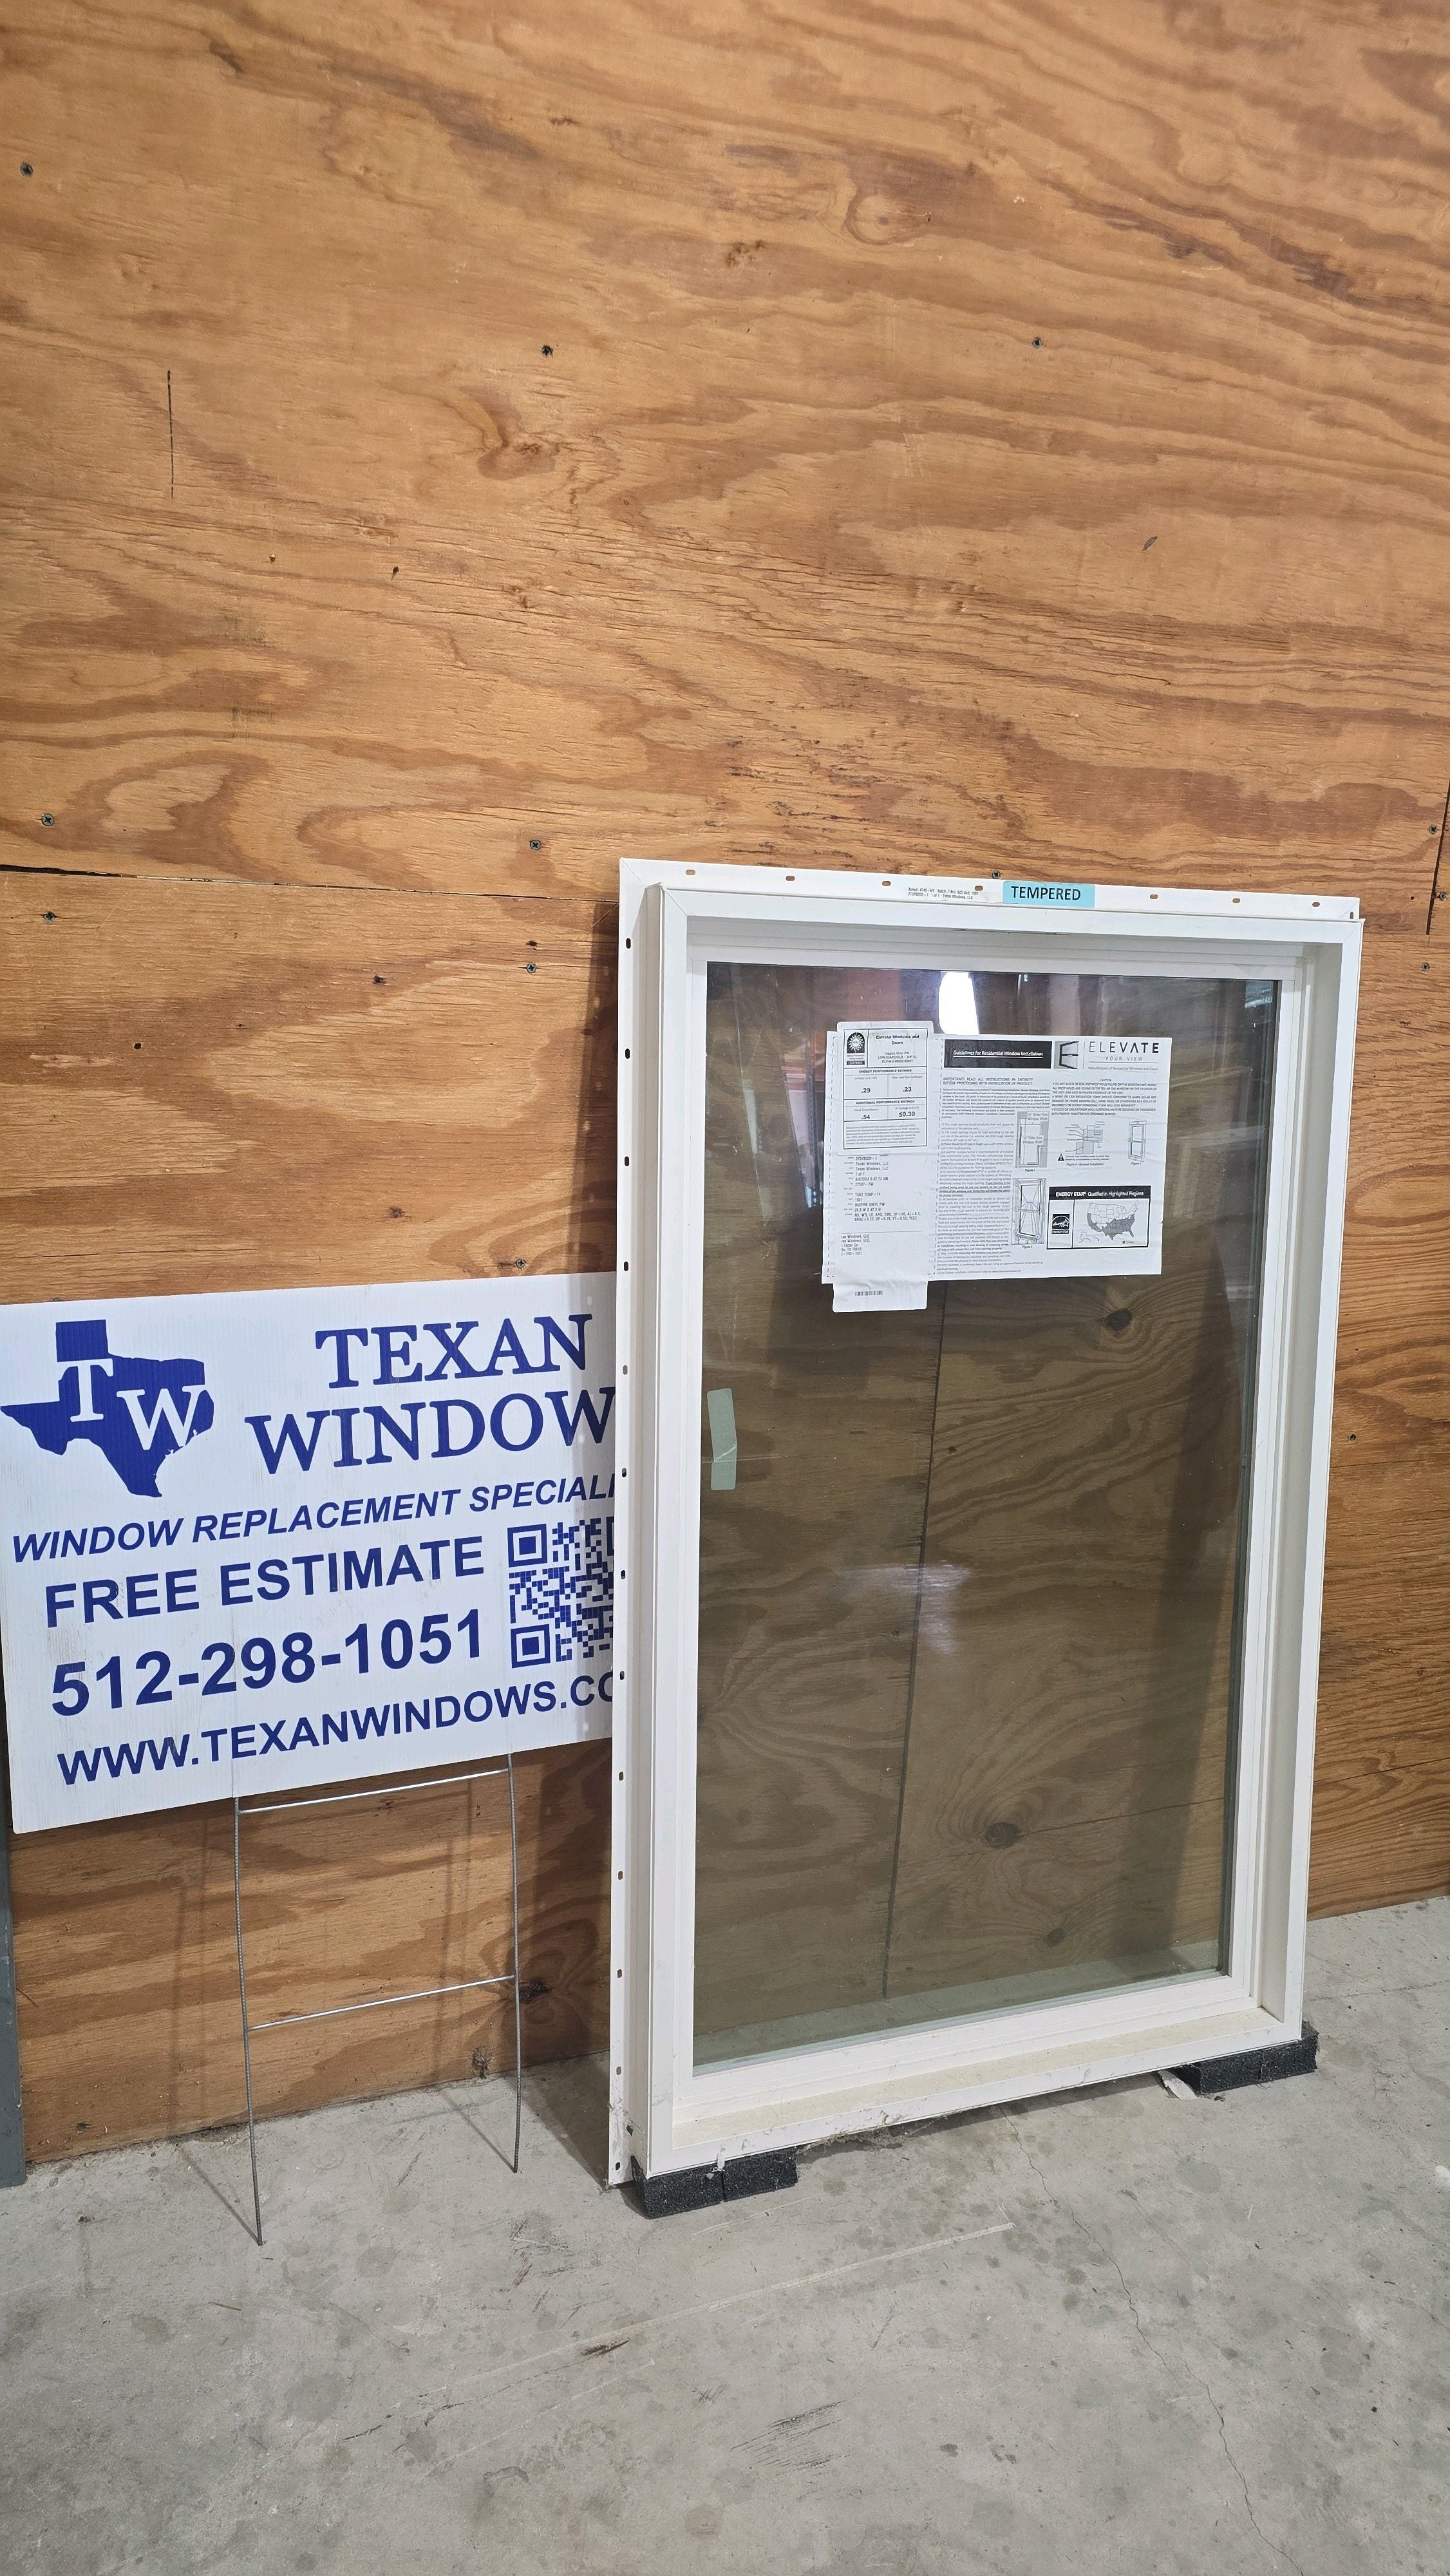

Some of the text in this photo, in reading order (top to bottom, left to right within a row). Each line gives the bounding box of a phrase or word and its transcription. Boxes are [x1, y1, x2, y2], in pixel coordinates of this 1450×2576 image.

[1011, 886, 1081, 901] TEMPERED
[1089, 1041, 1159, 1053] ELEVATE
[315, 1314, 592, 1388] TEXAN
[57, 1358, 207, 1451] TW
[14, 1519, 183, 1562] WINDOW
[193, 1490, 460, 1542] REPLACEMENT
[46, 1537, 484, 1627] FREE ESTIMATE
[53, 1609, 479, 1716] 512-298-1051
